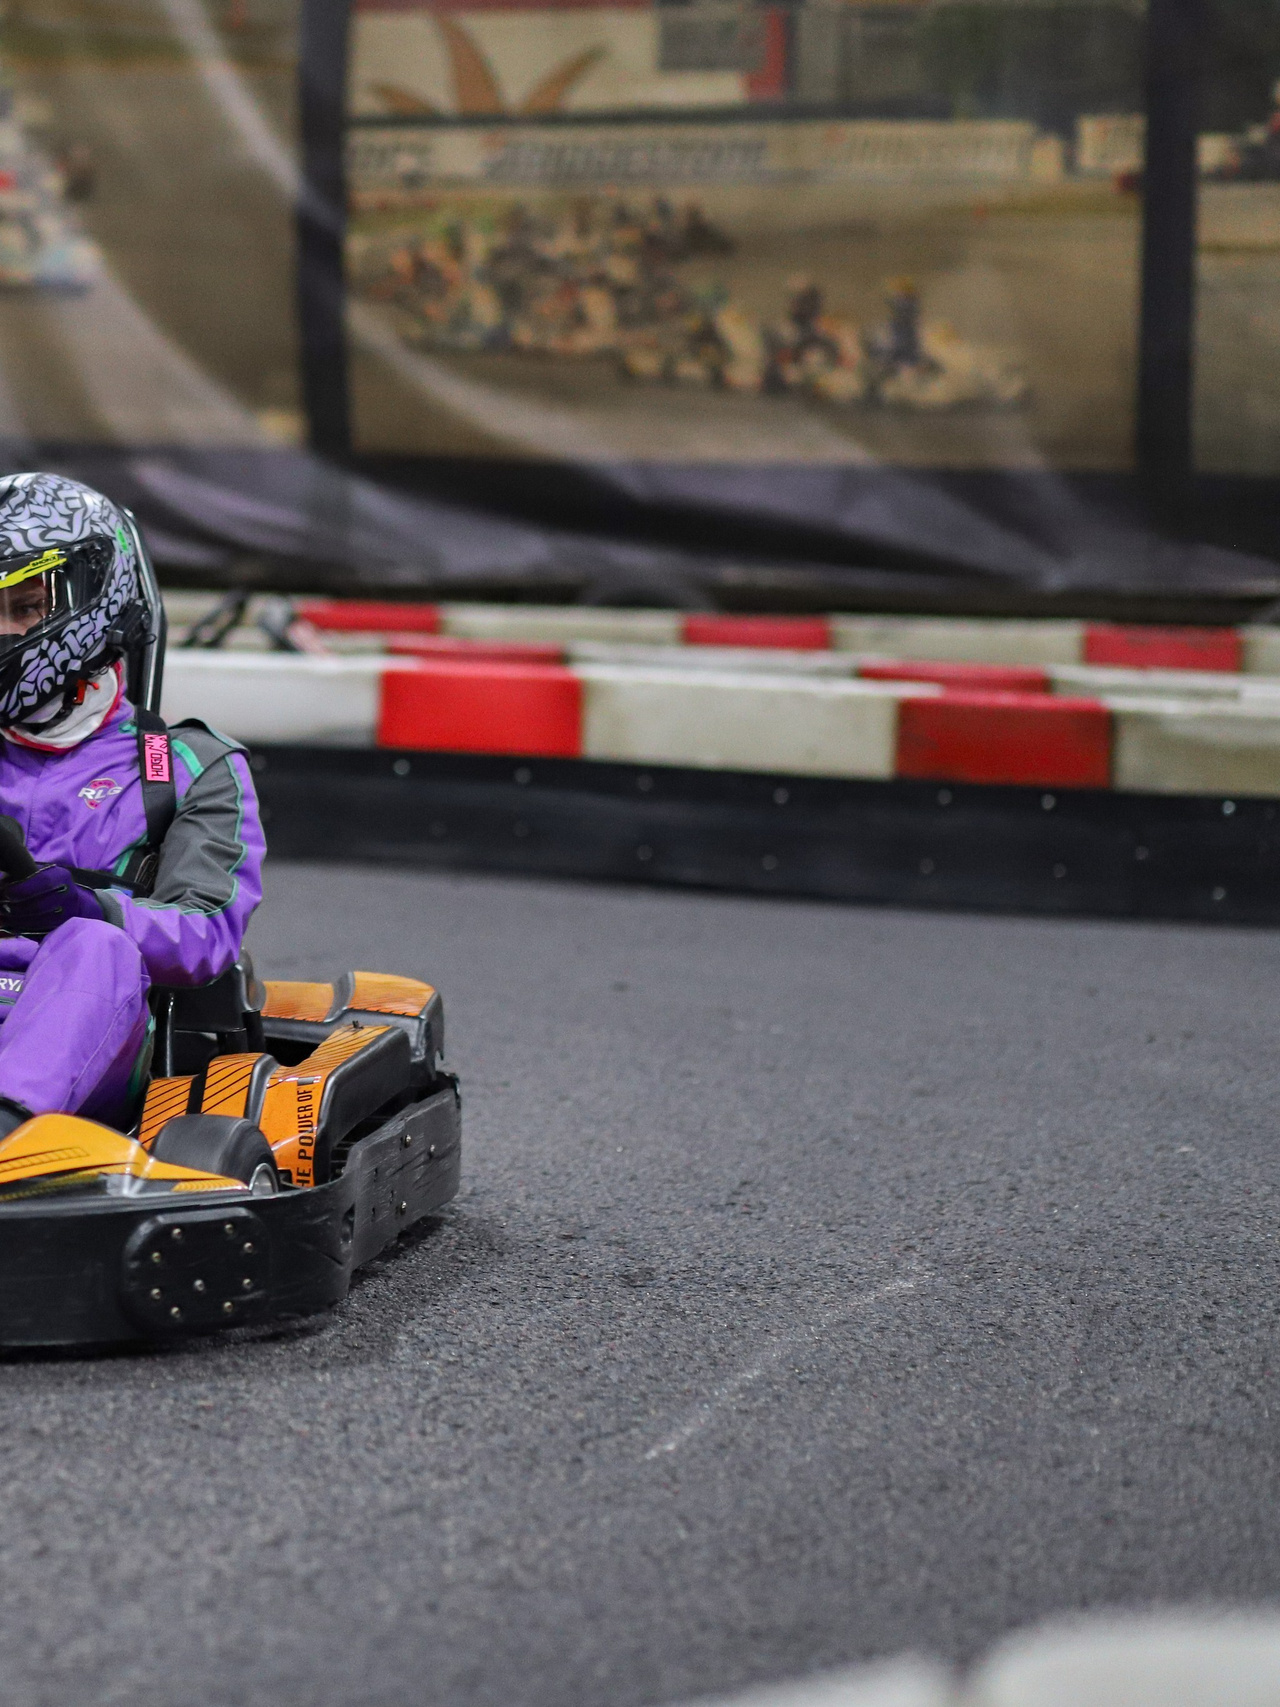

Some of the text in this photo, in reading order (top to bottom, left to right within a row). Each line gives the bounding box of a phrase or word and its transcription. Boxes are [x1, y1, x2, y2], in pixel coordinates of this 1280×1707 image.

[78, 786, 123, 800] RLG
[297, 1089, 313, 1102] OF
[297, 1104, 314, 1161] POWER
